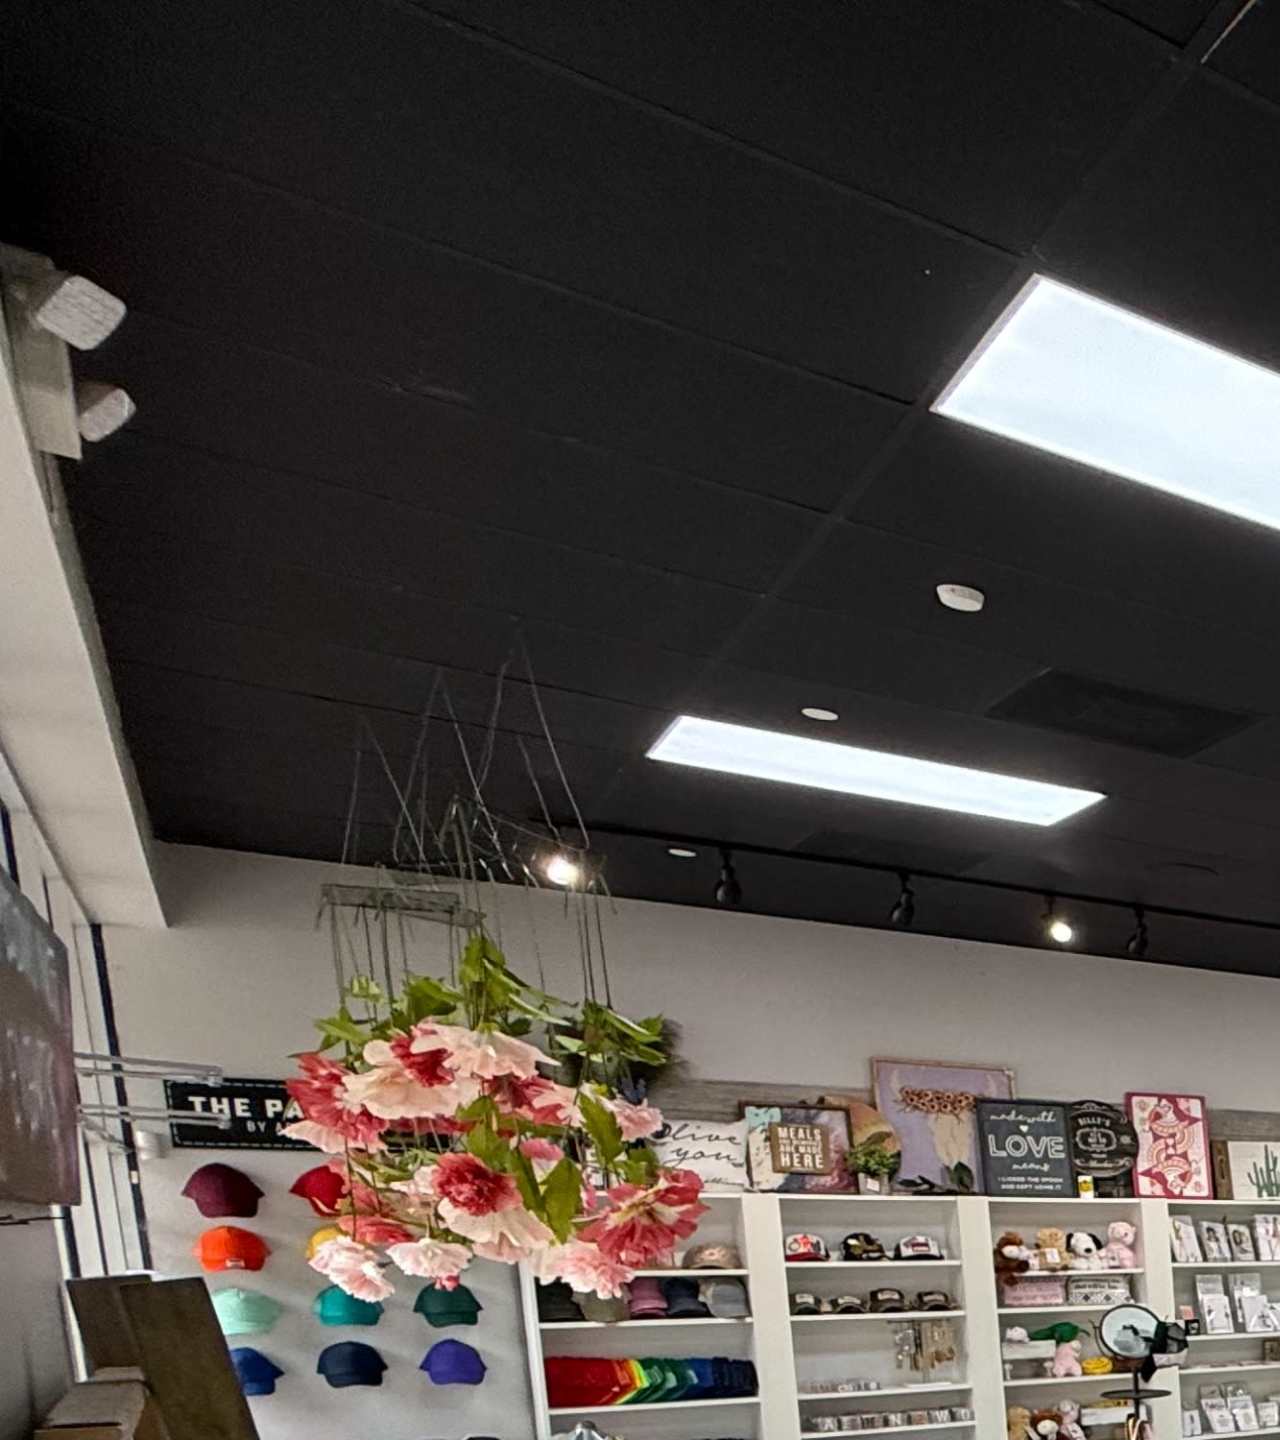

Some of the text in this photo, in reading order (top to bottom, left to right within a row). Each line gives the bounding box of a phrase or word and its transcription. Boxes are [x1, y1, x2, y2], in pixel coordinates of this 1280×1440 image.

[188, 1096, 305, 1119] THE PA
[988, 1134, 1066, 1158] LOVE
[662, 1147, 738, 1168] you
[780, 1153, 824, 1168] HERE
